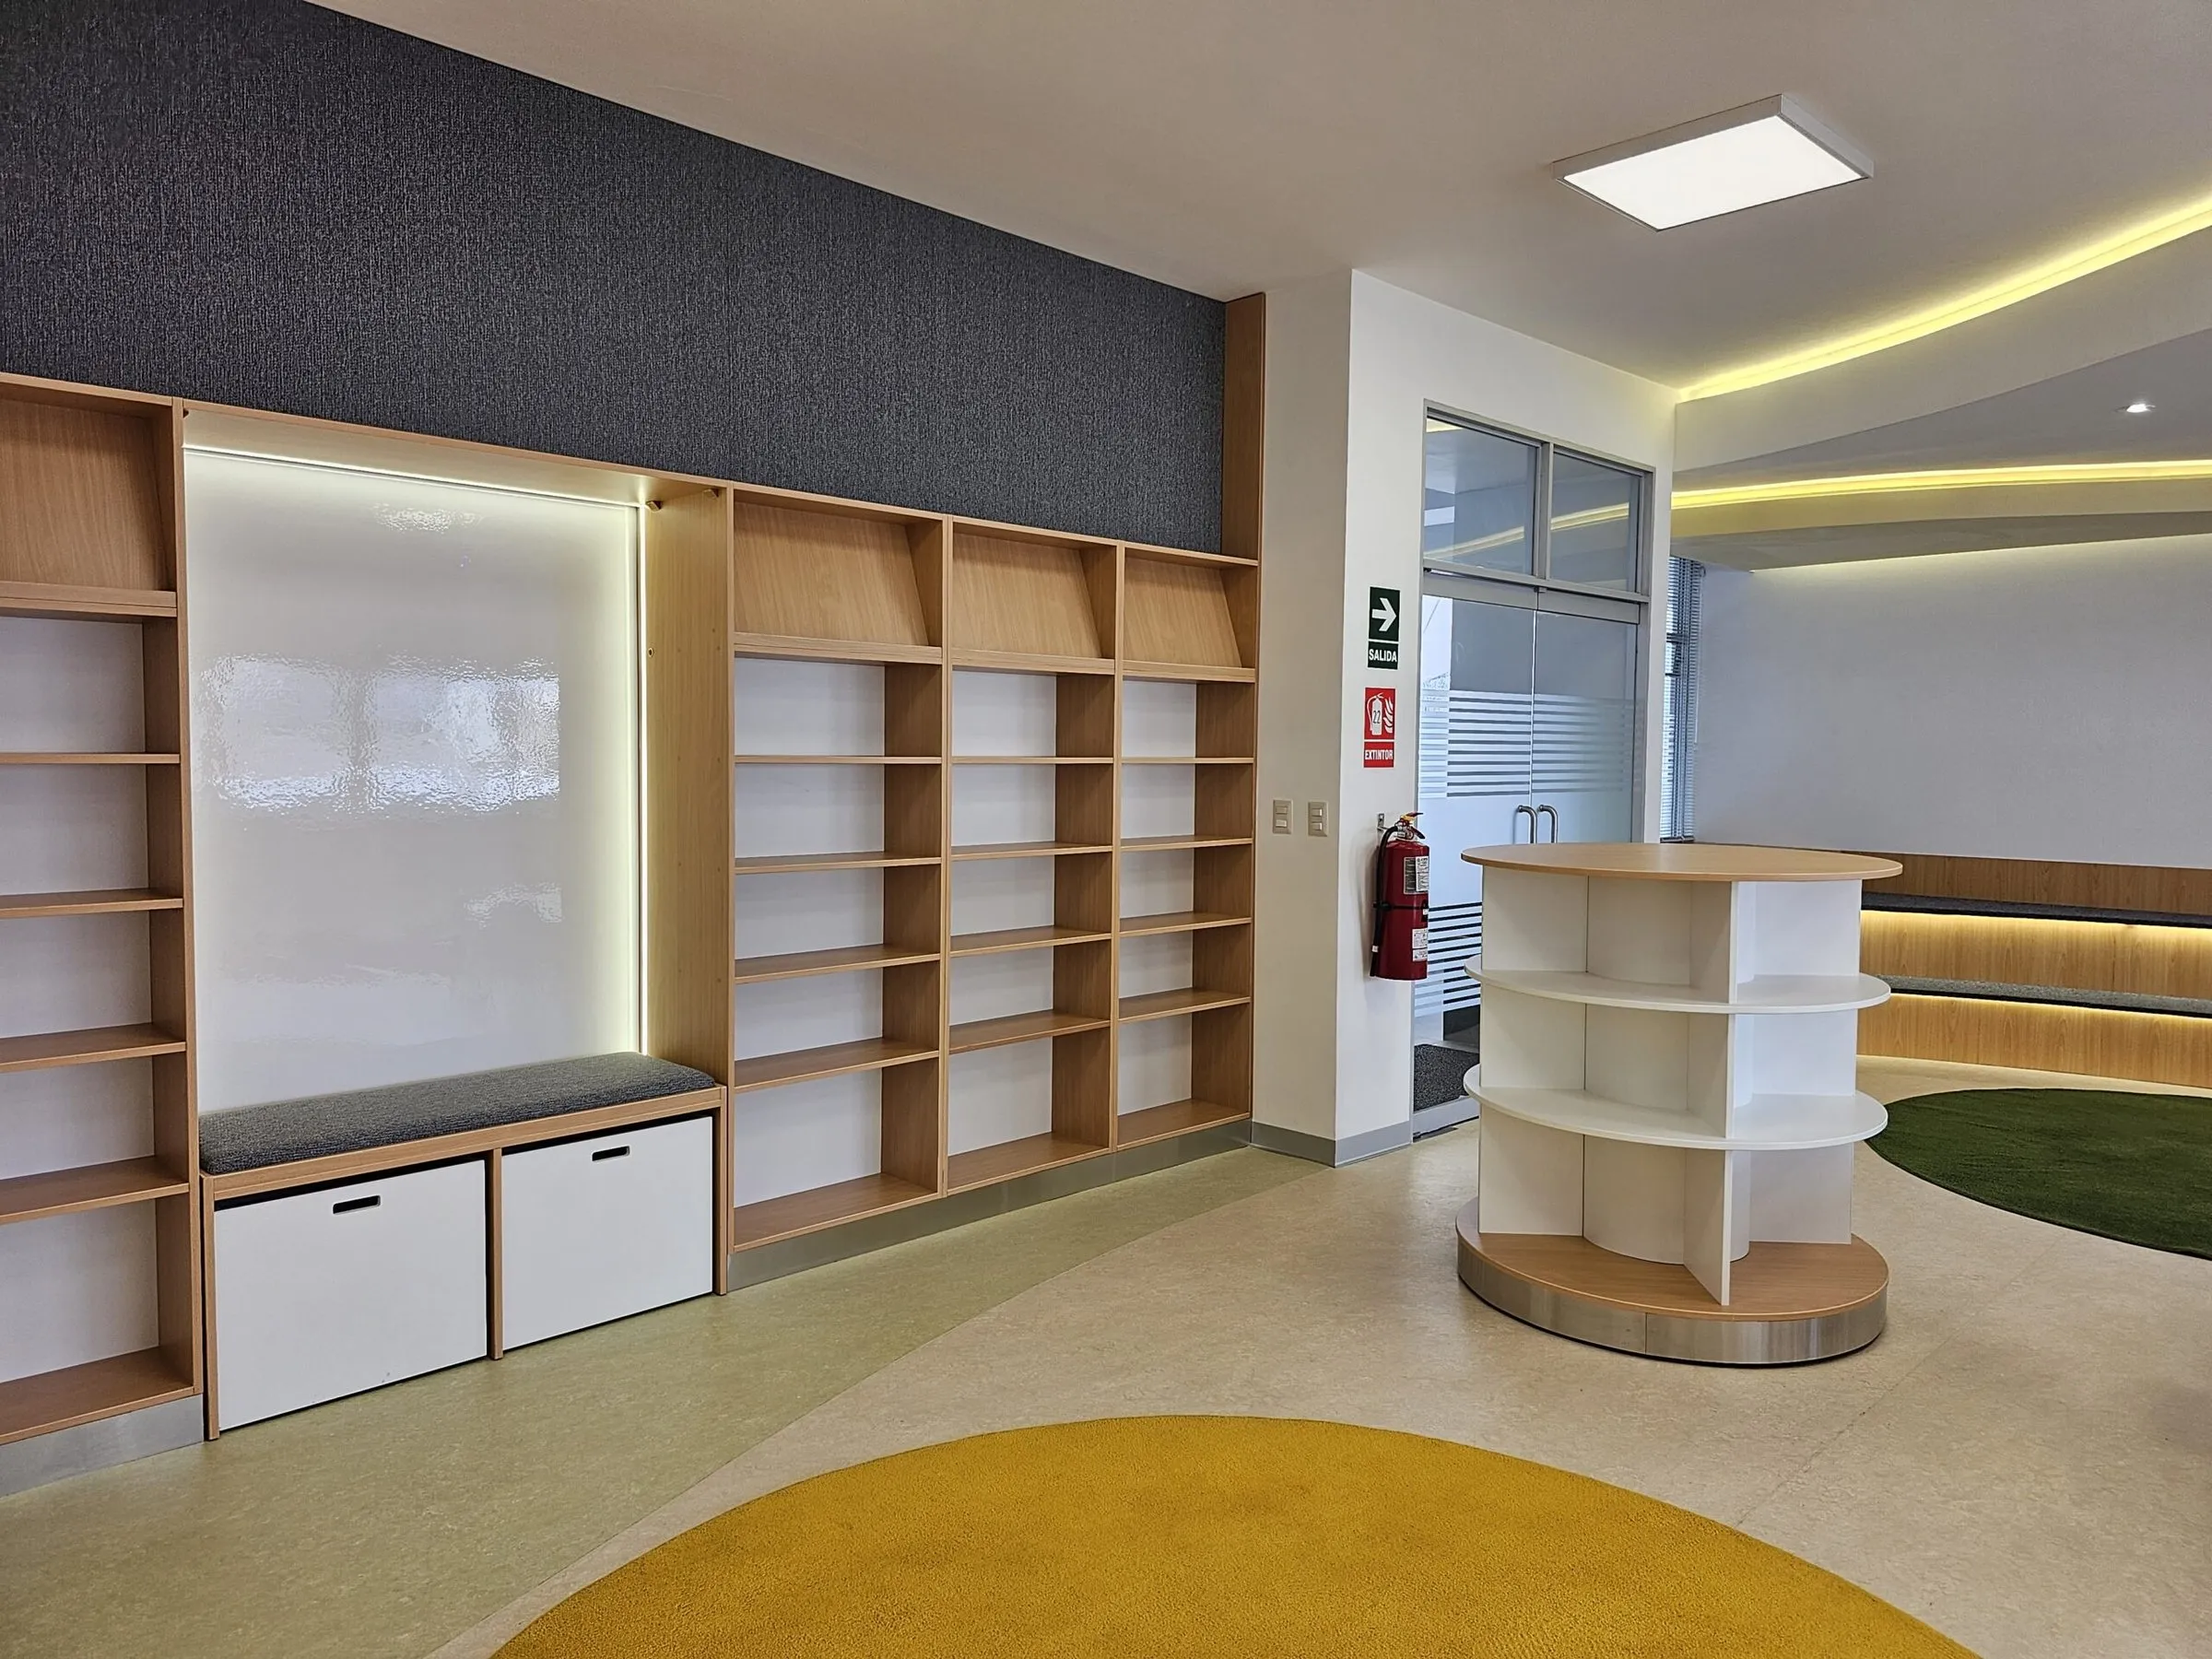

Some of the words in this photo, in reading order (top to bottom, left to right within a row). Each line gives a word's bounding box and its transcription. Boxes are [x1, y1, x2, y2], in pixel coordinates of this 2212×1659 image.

[1369, 648, 1397, 662] SALIDA
[1372, 710, 1381, 724] 22
[1364, 749, 1394, 760] EXTINTOR
